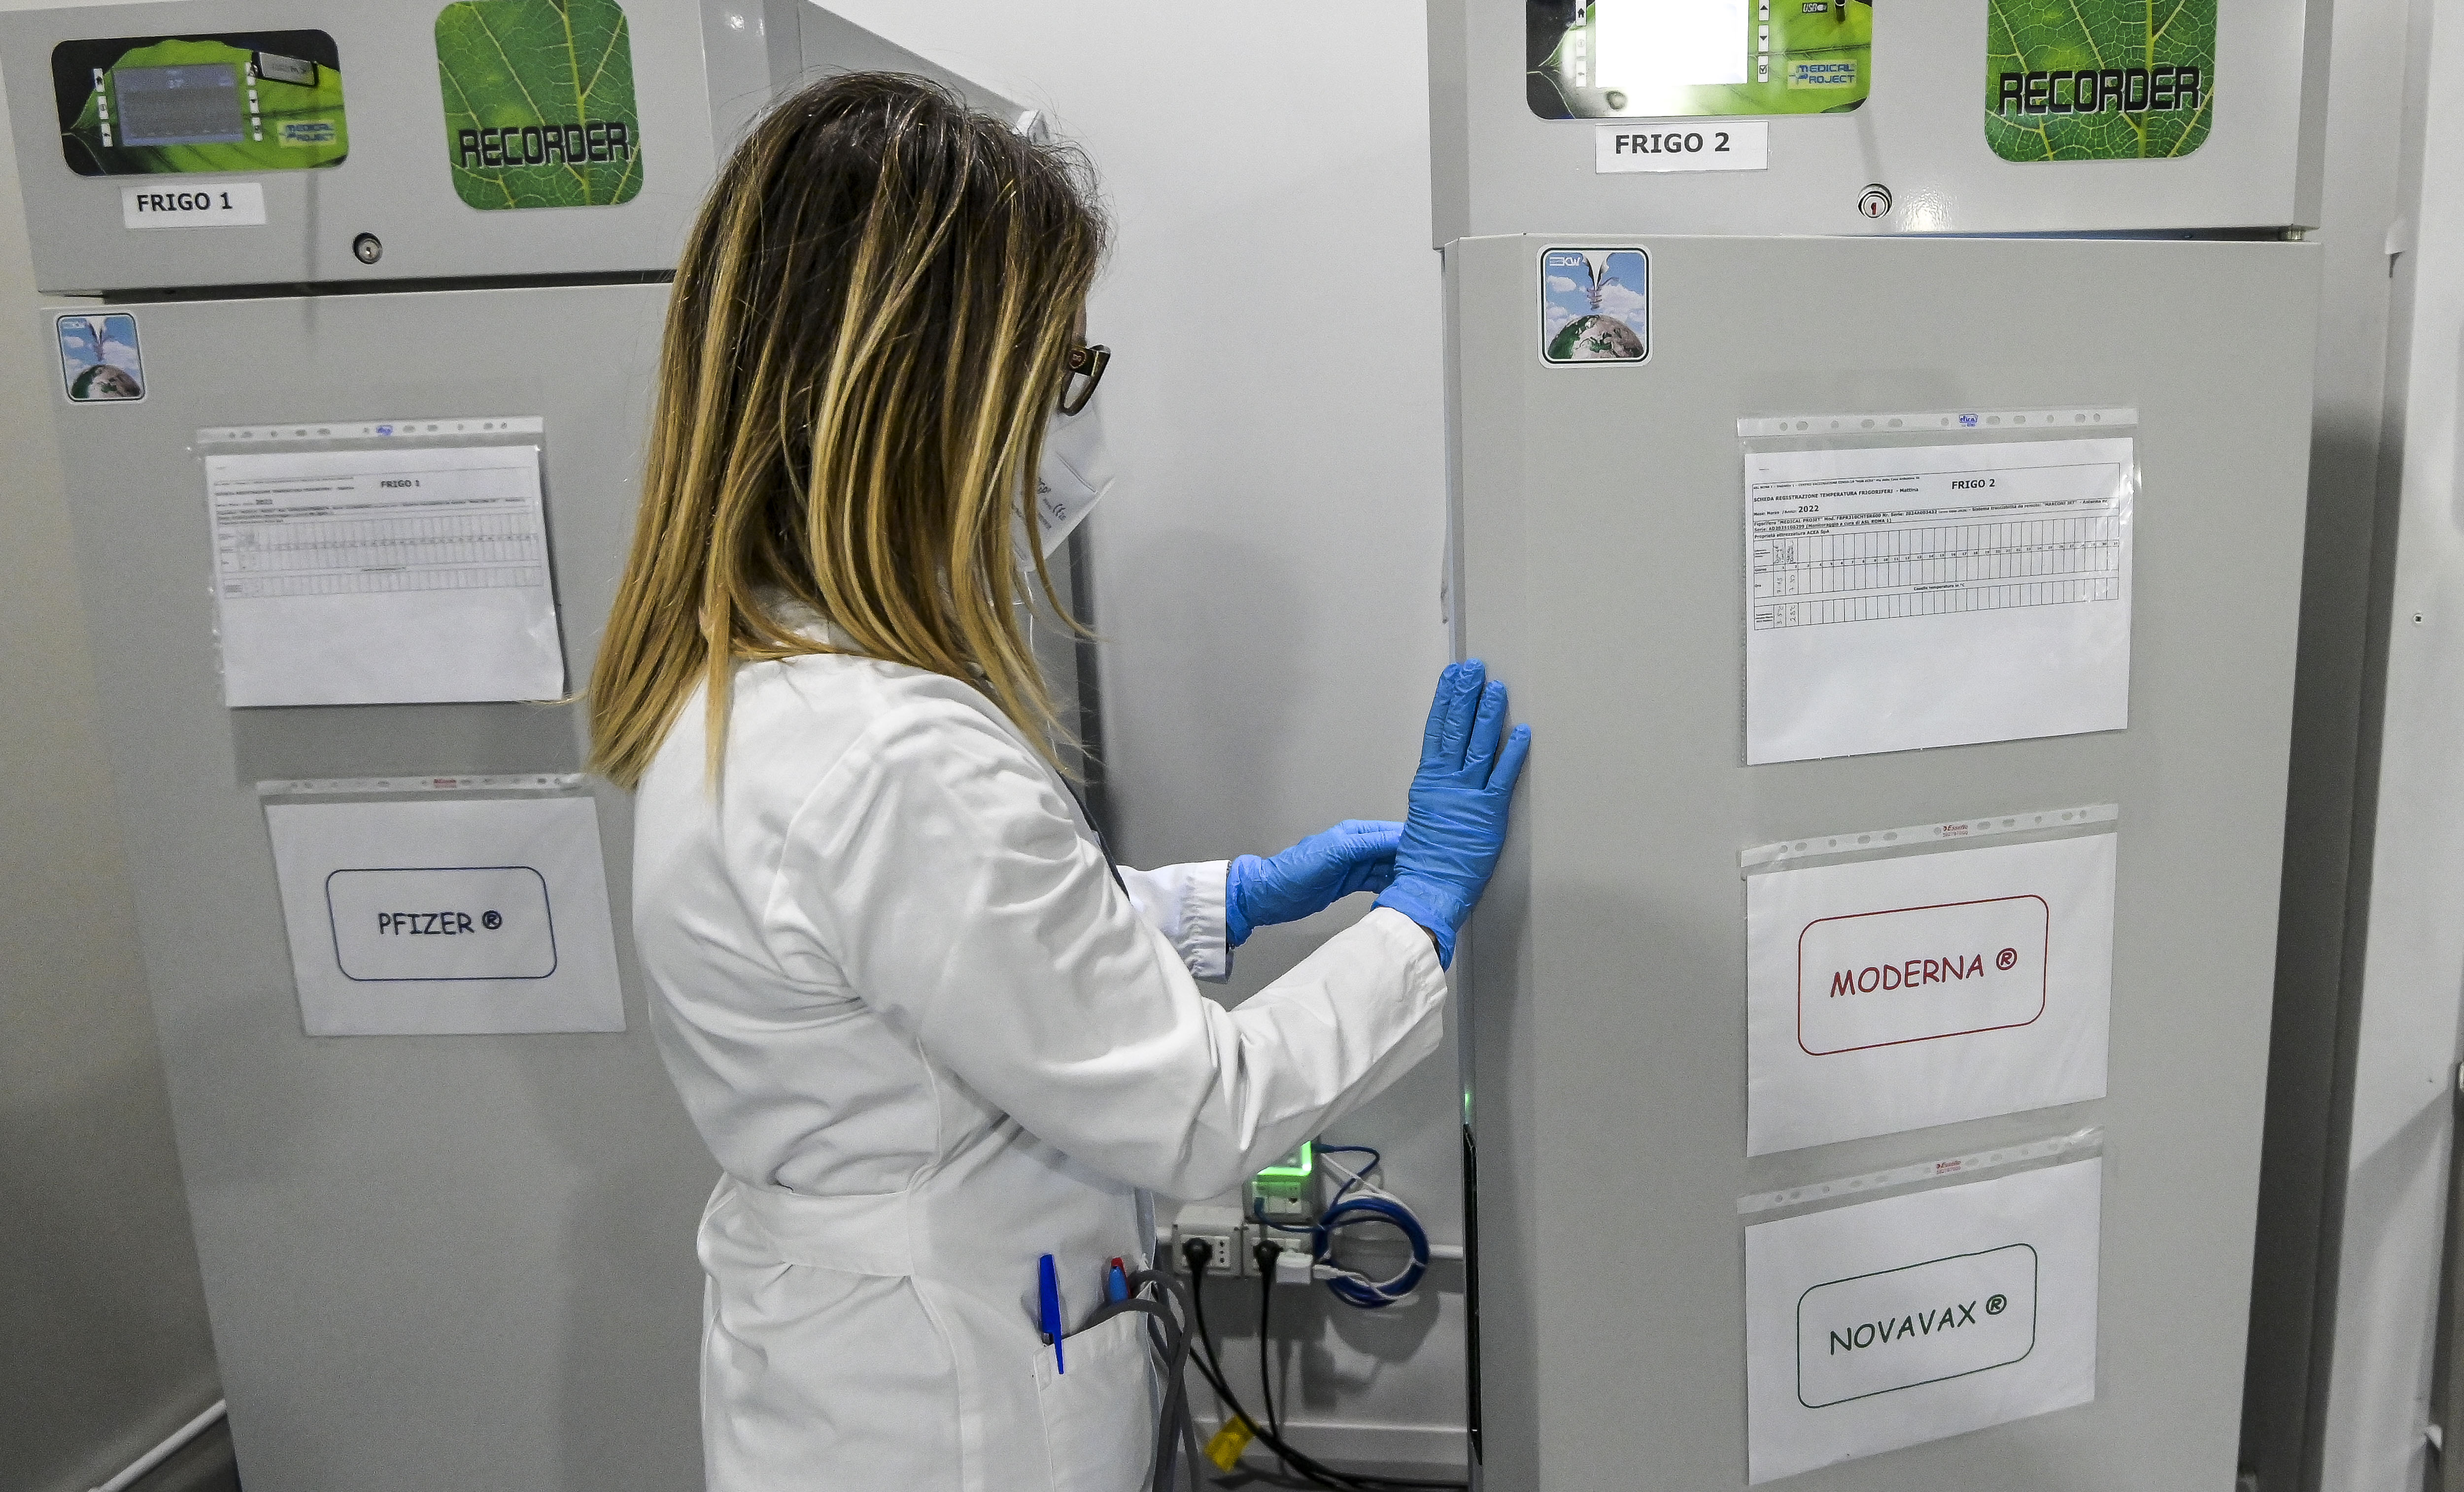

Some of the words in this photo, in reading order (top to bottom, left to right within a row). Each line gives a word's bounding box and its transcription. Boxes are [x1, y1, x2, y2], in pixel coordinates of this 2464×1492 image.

[1803, 3, 1817, 12] USB
[1798, 64, 1855, 72] MEDICAL
[1796, 74, 1855, 84] PROJECT
[1999, 67, 2200, 115] RECORDER
[459, 122, 630, 168] RECORDER
[1615, 133, 1703, 154] FRIGO
[1714, 132, 1730, 152] 2
[137, 193, 210, 212] FRIGO
[222, 192, 233, 210] 1
[380, 479, 411, 488] FRIGO
[1951, 479, 1985, 489] FRIGO
[1989, 478, 1995, 487] 2
[377, 912, 475, 936] PFIZER
[1830, 953, 1985, 998] MODERNA
[1830, 1300, 1977, 1355] NOVAVAX
